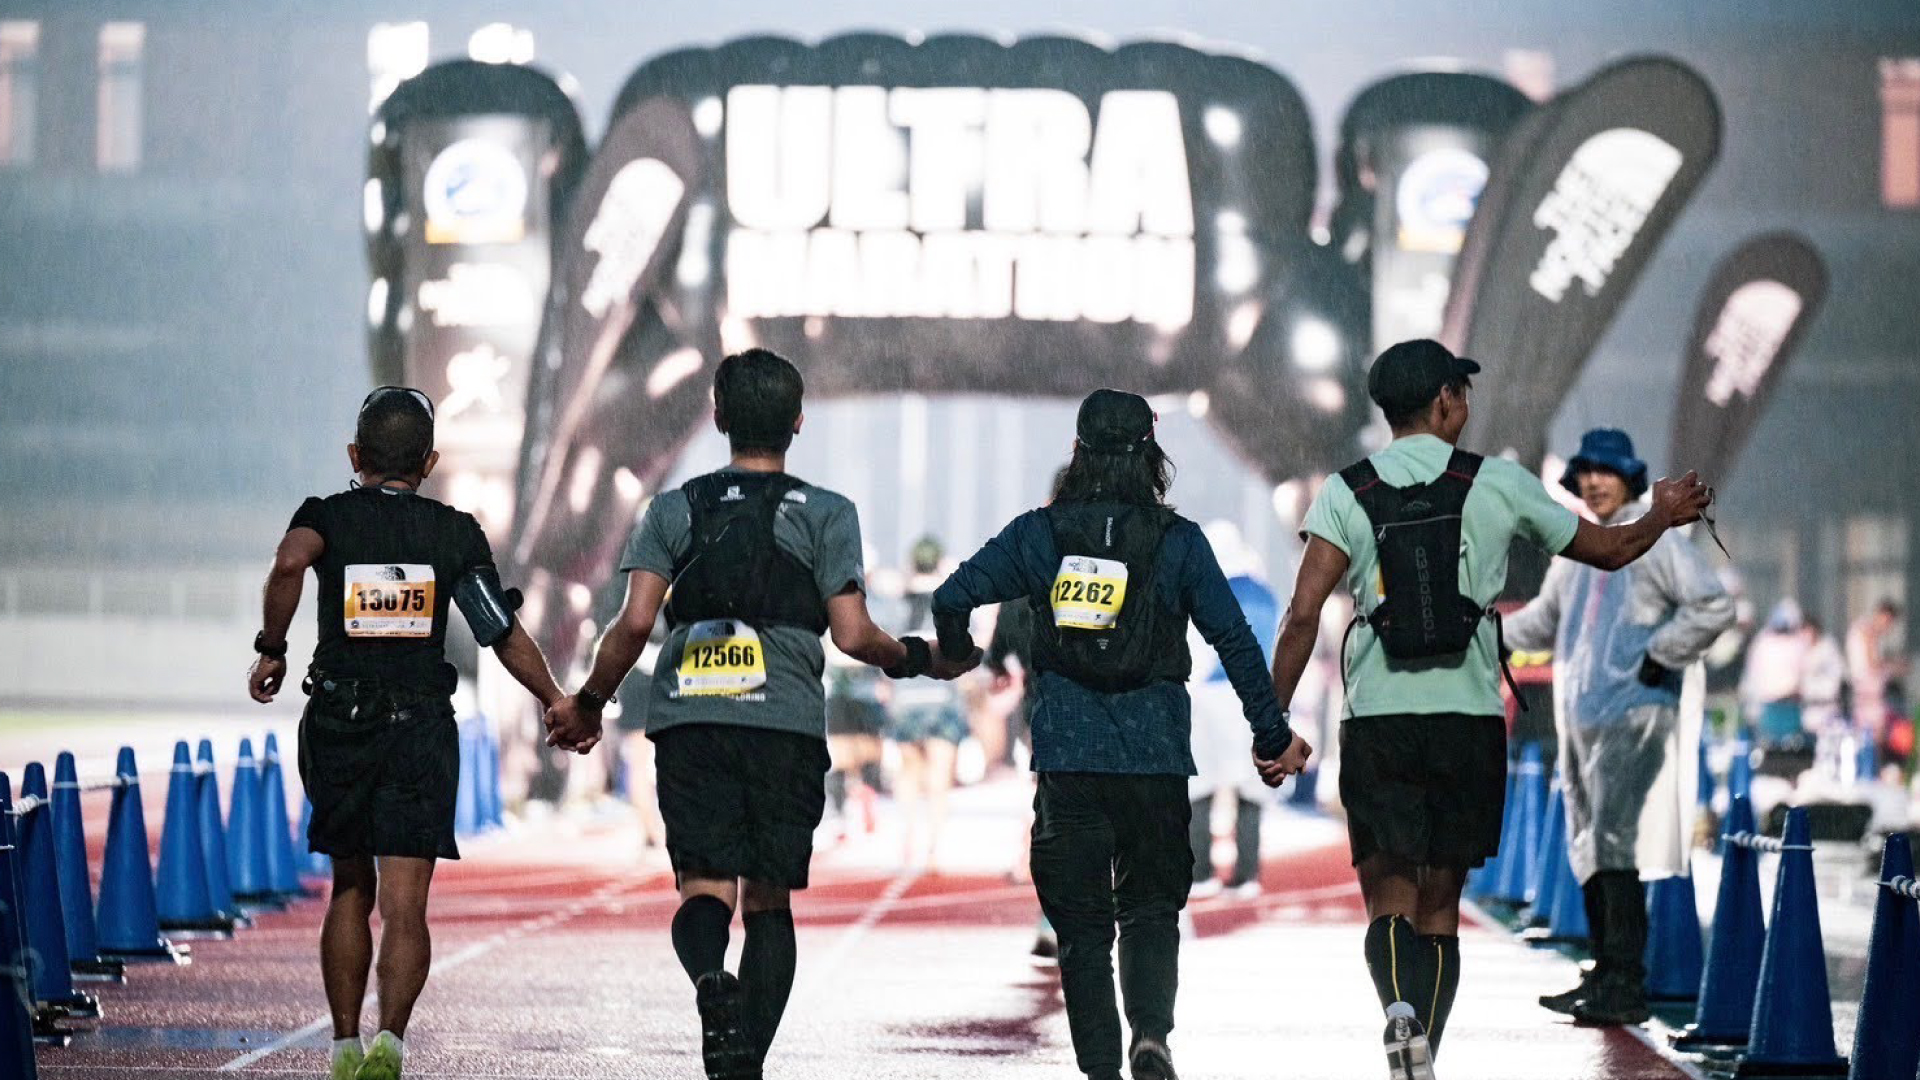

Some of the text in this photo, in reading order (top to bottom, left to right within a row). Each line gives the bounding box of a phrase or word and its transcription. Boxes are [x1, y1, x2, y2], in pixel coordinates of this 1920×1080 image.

[726, 84, 1194, 235] ULTRA
[357, 589, 425, 611] 13075
[1054, 580, 1115, 606] 12262
[692, 644, 755, 668] 12566
